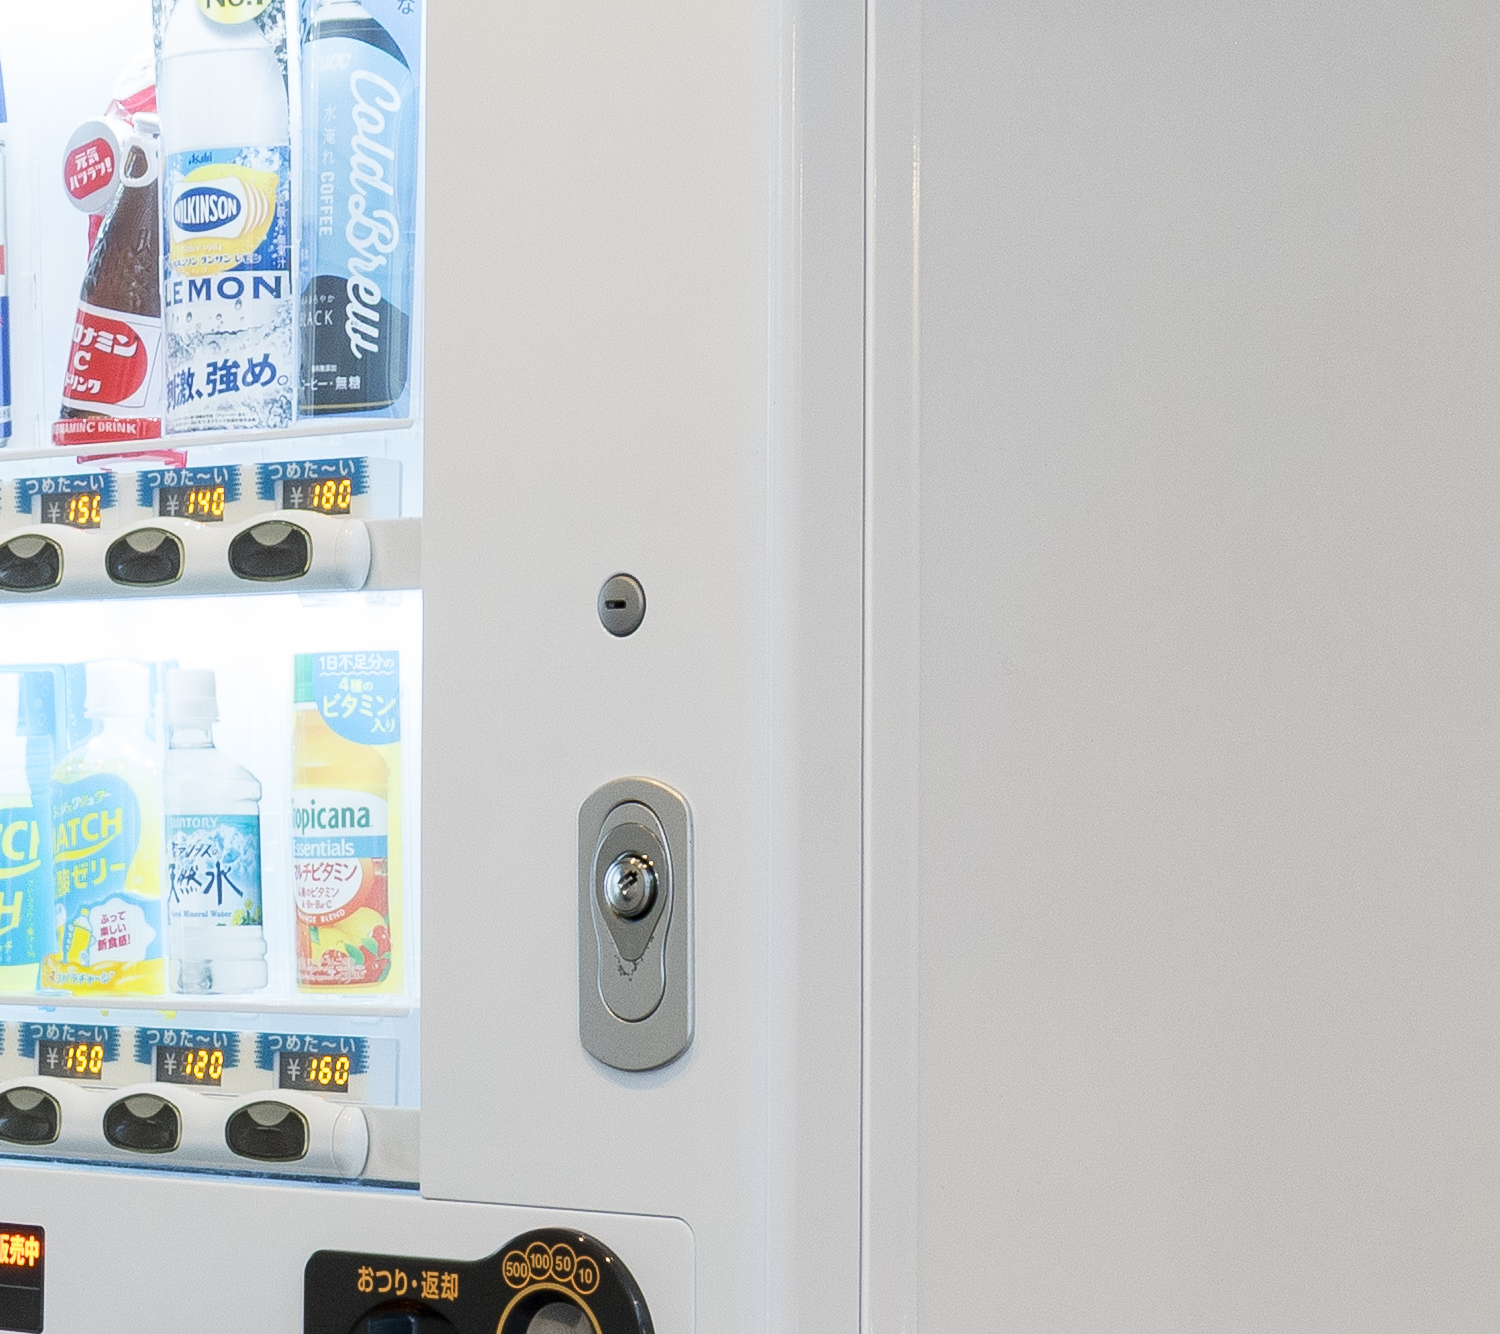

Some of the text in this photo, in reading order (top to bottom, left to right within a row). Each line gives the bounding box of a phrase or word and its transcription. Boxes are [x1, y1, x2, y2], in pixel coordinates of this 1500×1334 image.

[74, 145, 100, 170] 元気
[188, 152, 212, 165] Asahi
[70, 157, 113, 191] ハツラツ!
[319, 171, 334, 237] COFFEE
[166, 275, 282, 307] LEMON
[73, 350, 91, 372] C
[319, 654, 394, 670] 1日不足分の
[339, 678, 373, 693] 4種の
[323, 694, 396, 717] ビタミン
[370, 719, 395, 733] 入り
[210, 909, 232, 917] Water
[506, 1253, 593, 1284] 500 100 50 10
[357, 1267, 459, 1302] おつり・返却
